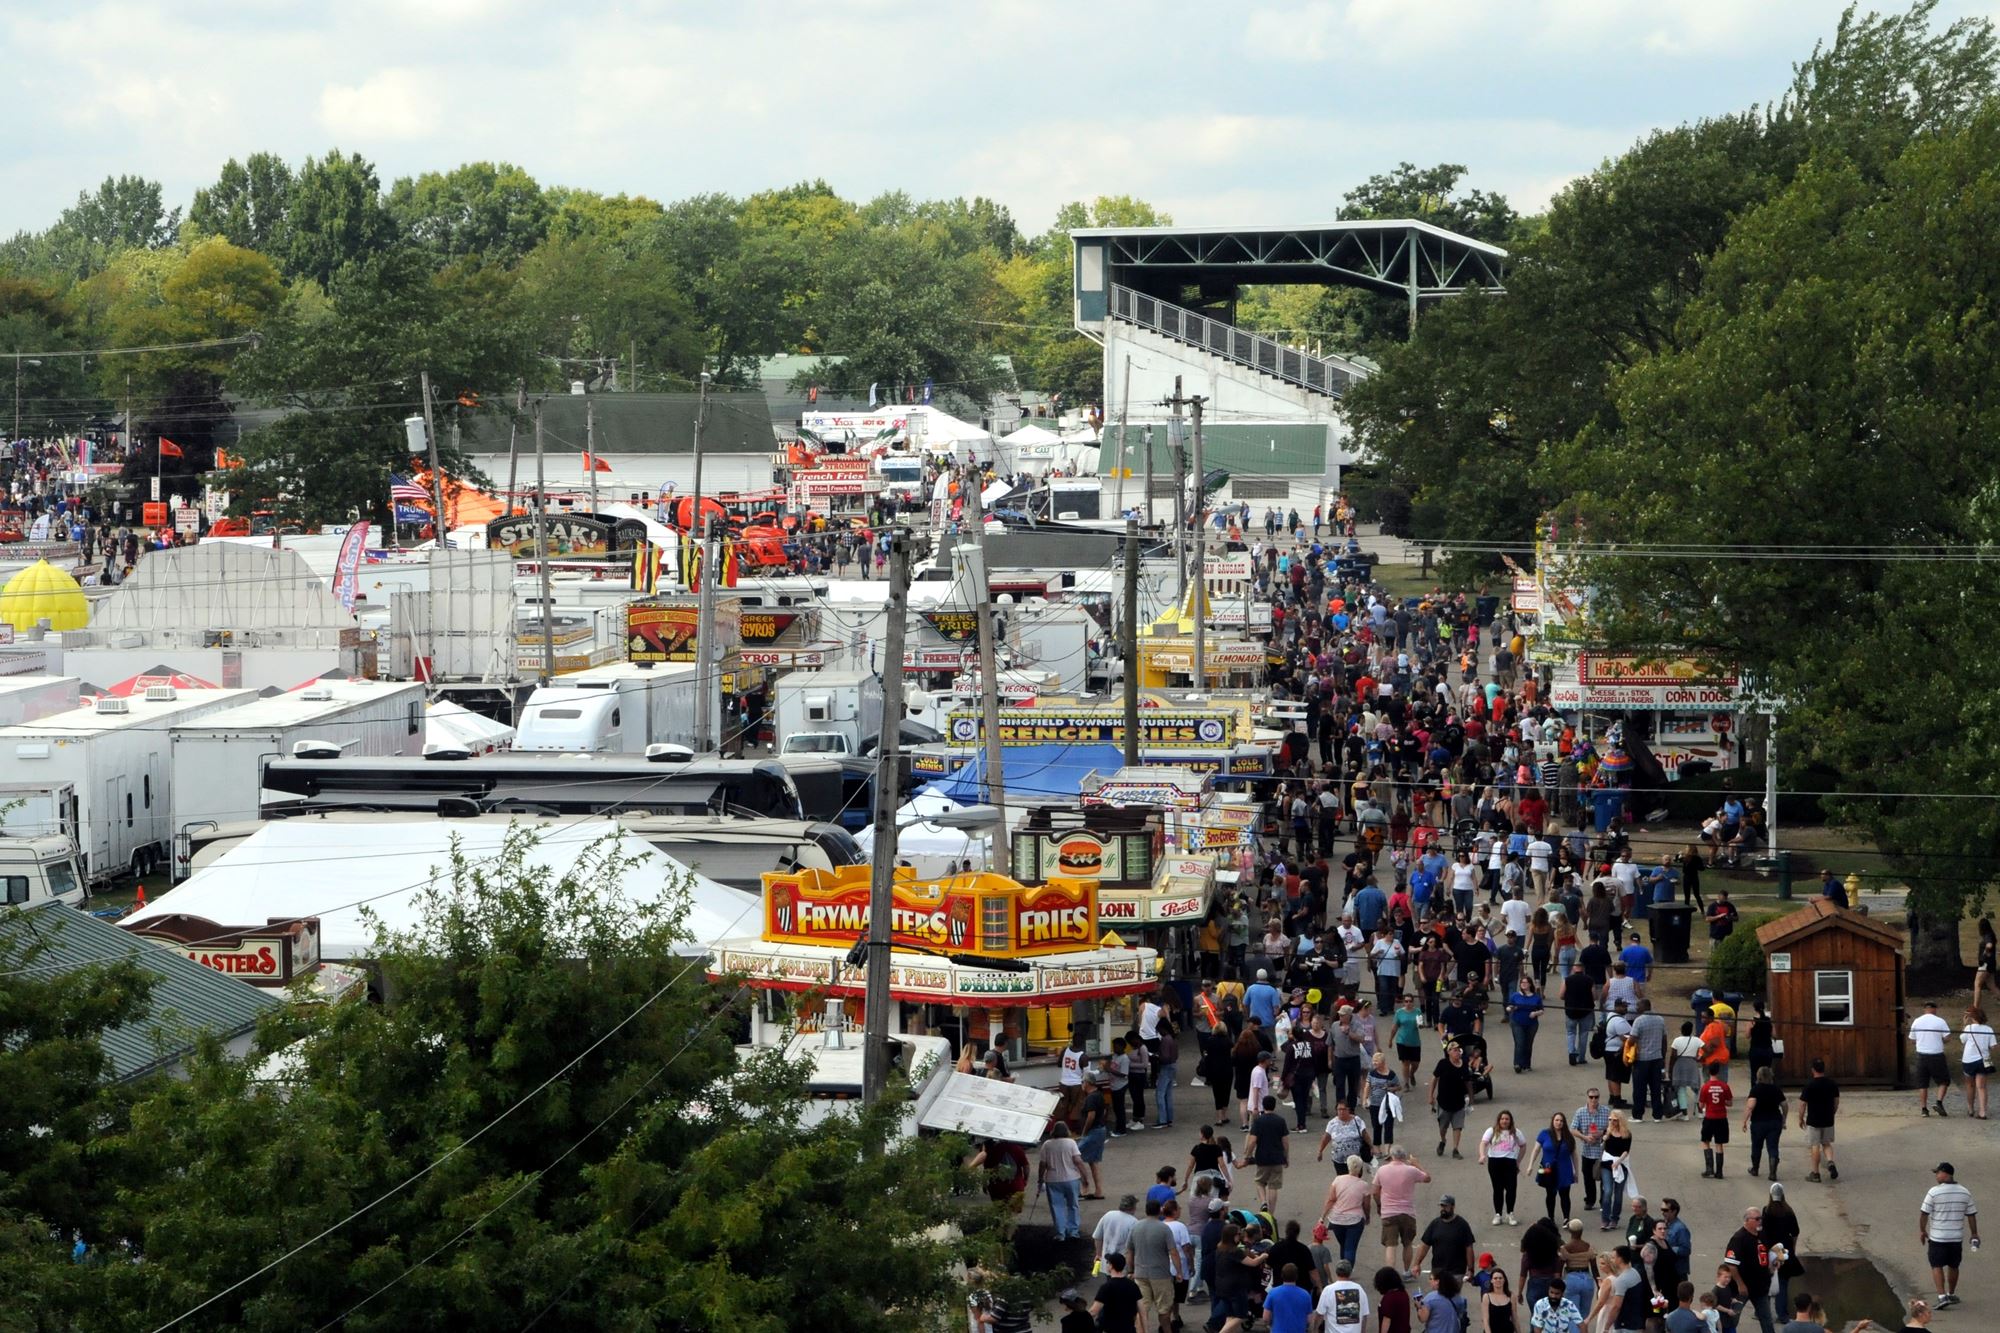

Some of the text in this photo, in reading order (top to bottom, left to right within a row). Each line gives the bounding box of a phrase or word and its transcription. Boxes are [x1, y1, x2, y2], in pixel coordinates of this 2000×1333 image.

[795, 472, 865, 481] French Fries
[934, 614, 976, 622] FRENC
[742, 623, 775, 638] GYROS
[939, 621, 977, 631] FRIES
[742, 653, 780, 664] YROS
[962, 653, 982, 663] FRI
[1213, 654, 1263, 664] LEMONADE
[1004, 684, 1038, 693] VEGGIES
[1590, 689, 1617, 697] CHEESE
[1631, 689, 1650, 697] STICK
[1586, 696, 1655, 704] MOZZARELLA FINGERS
[1665, 691, 1696, 703] CORN
[998, 718, 1194, 727] RINGFIELD TOWNSHI RURITAN
[980, 726, 1101, 741] RENCH
[1235, 758, 1259, 766] COLD
[915, 763, 943, 772] DRINKS
[1231, 764, 1264, 773] DRINKS
[1207, 830, 1238, 844] Sno-Cones
[1099, 903, 1136, 917] LOIN
[797, 901, 949, 945] FRYMATERS
[1020, 905, 1090, 947] FRIES
[727, 953, 773, 973] CRISPY
[778, 957, 831, 980] GOLDEN
[904, 967, 948, 989] FRIES
[976, 971, 1018, 979] COLD
[1045, 968, 1095, 989] FRENCH
[1099, 962, 1137, 982] FRIES
[959, 976, 1035, 993] DRINKS
[1064, 1057, 1077, 1071] 23
[1711, 1093, 1721, 1105] 5
